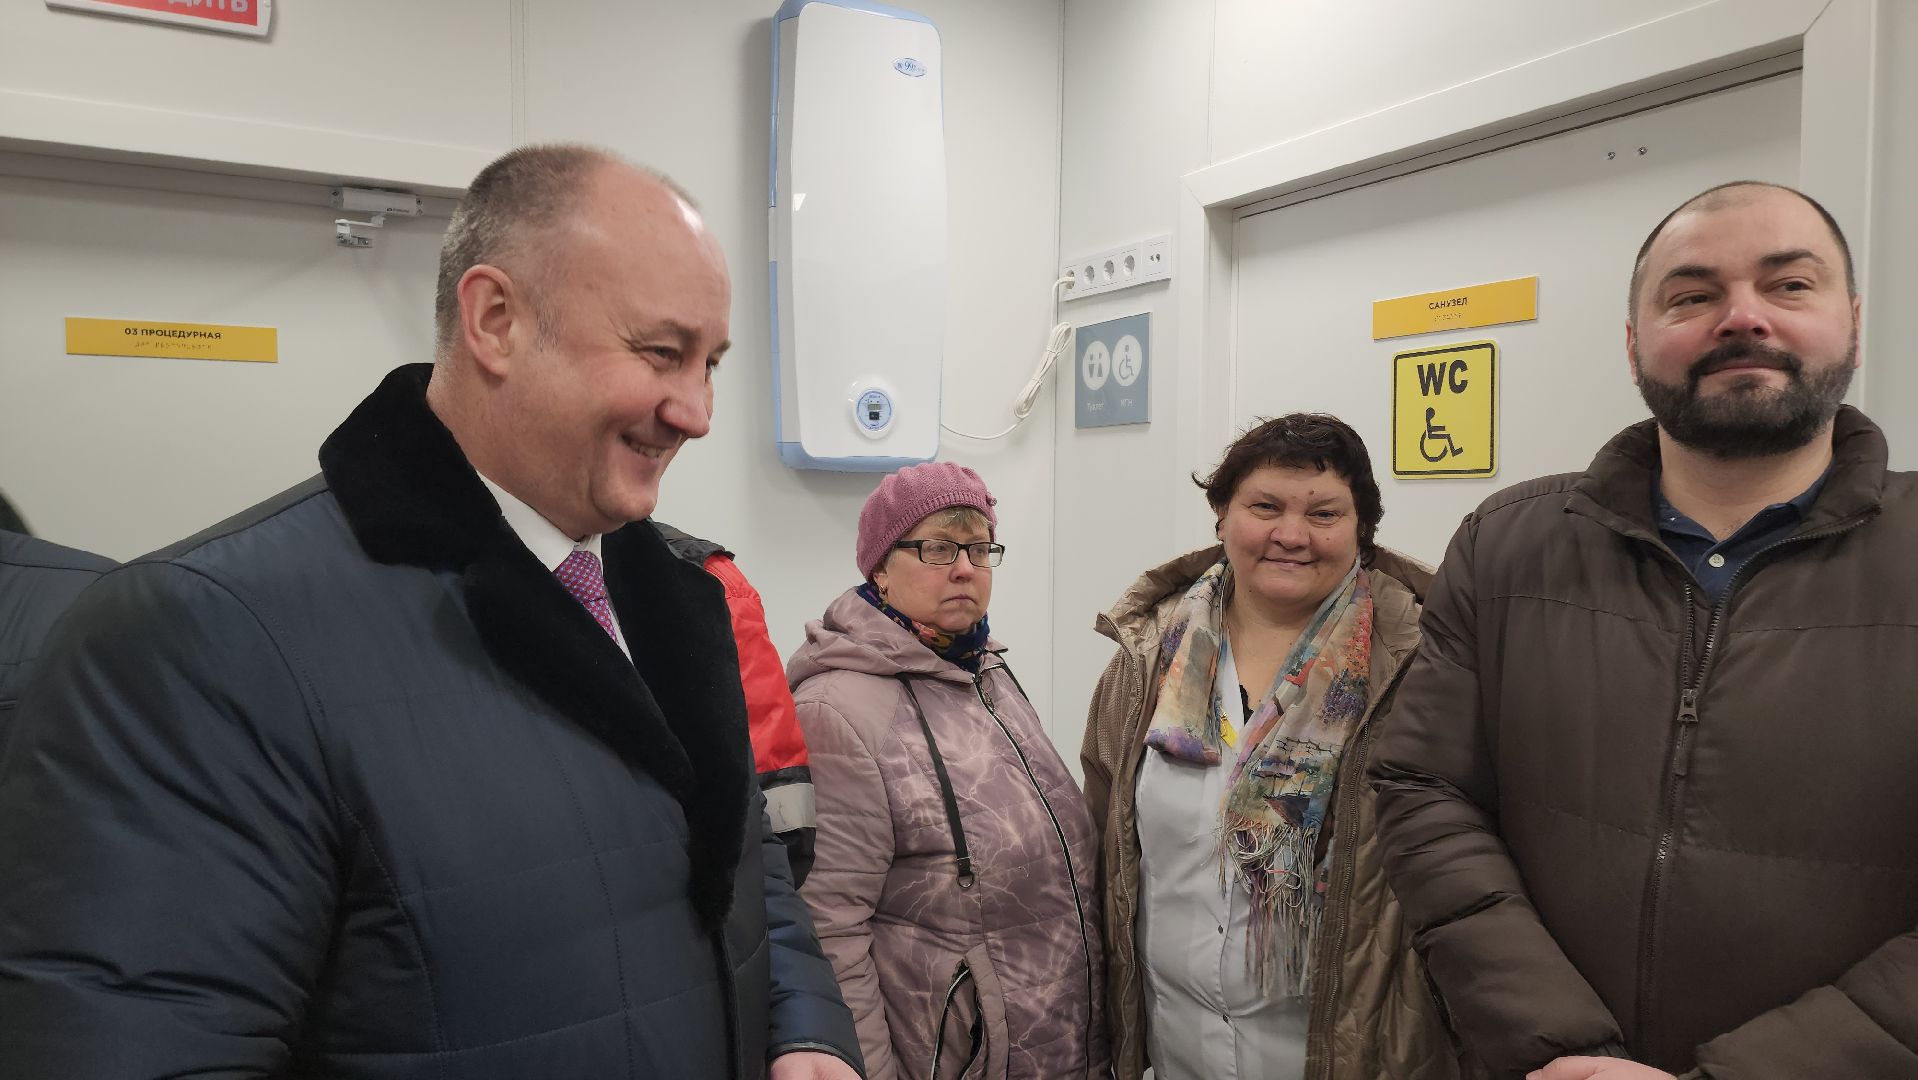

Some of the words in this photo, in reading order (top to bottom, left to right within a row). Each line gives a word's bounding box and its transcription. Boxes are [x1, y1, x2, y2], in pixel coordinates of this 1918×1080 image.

[1428, 297, 1468, 310] САНУЗЕЛ
[124, 327, 138, 336] 03
[141, 328, 221, 340] ПРОЦЕДУРНАЯ
[1417, 359, 1468, 397] WC
